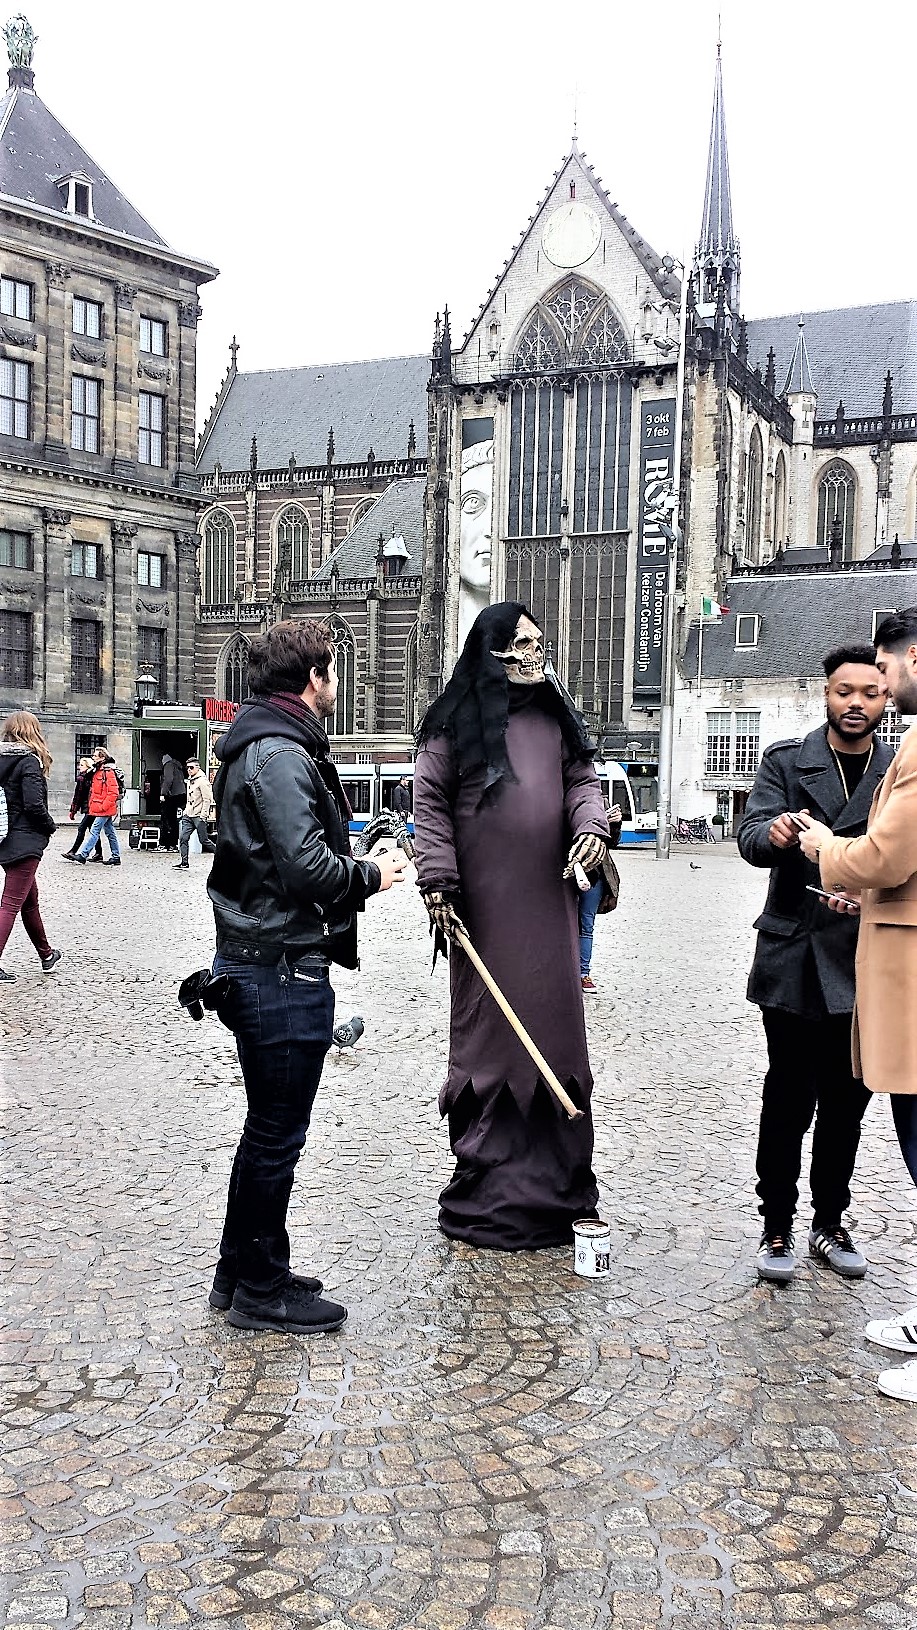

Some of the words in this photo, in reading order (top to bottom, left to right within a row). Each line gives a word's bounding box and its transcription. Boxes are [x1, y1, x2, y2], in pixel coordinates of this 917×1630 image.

[646, 414, 653, 425] 3
[654, 412, 670, 424] okt
[646, 427, 653, 438] 7
[653, 425, 670, 437] feb
[642, 457, 671, 557] ROME
[641, 572, 653, 608] keizer
[655, 572, 666, 587] De
[653, 589, 665, 626] droom
[637, 609, 652, 672] Constantijn
[653, 627, 662, 648] van
[205, 697, 236, 723] BURGERS
